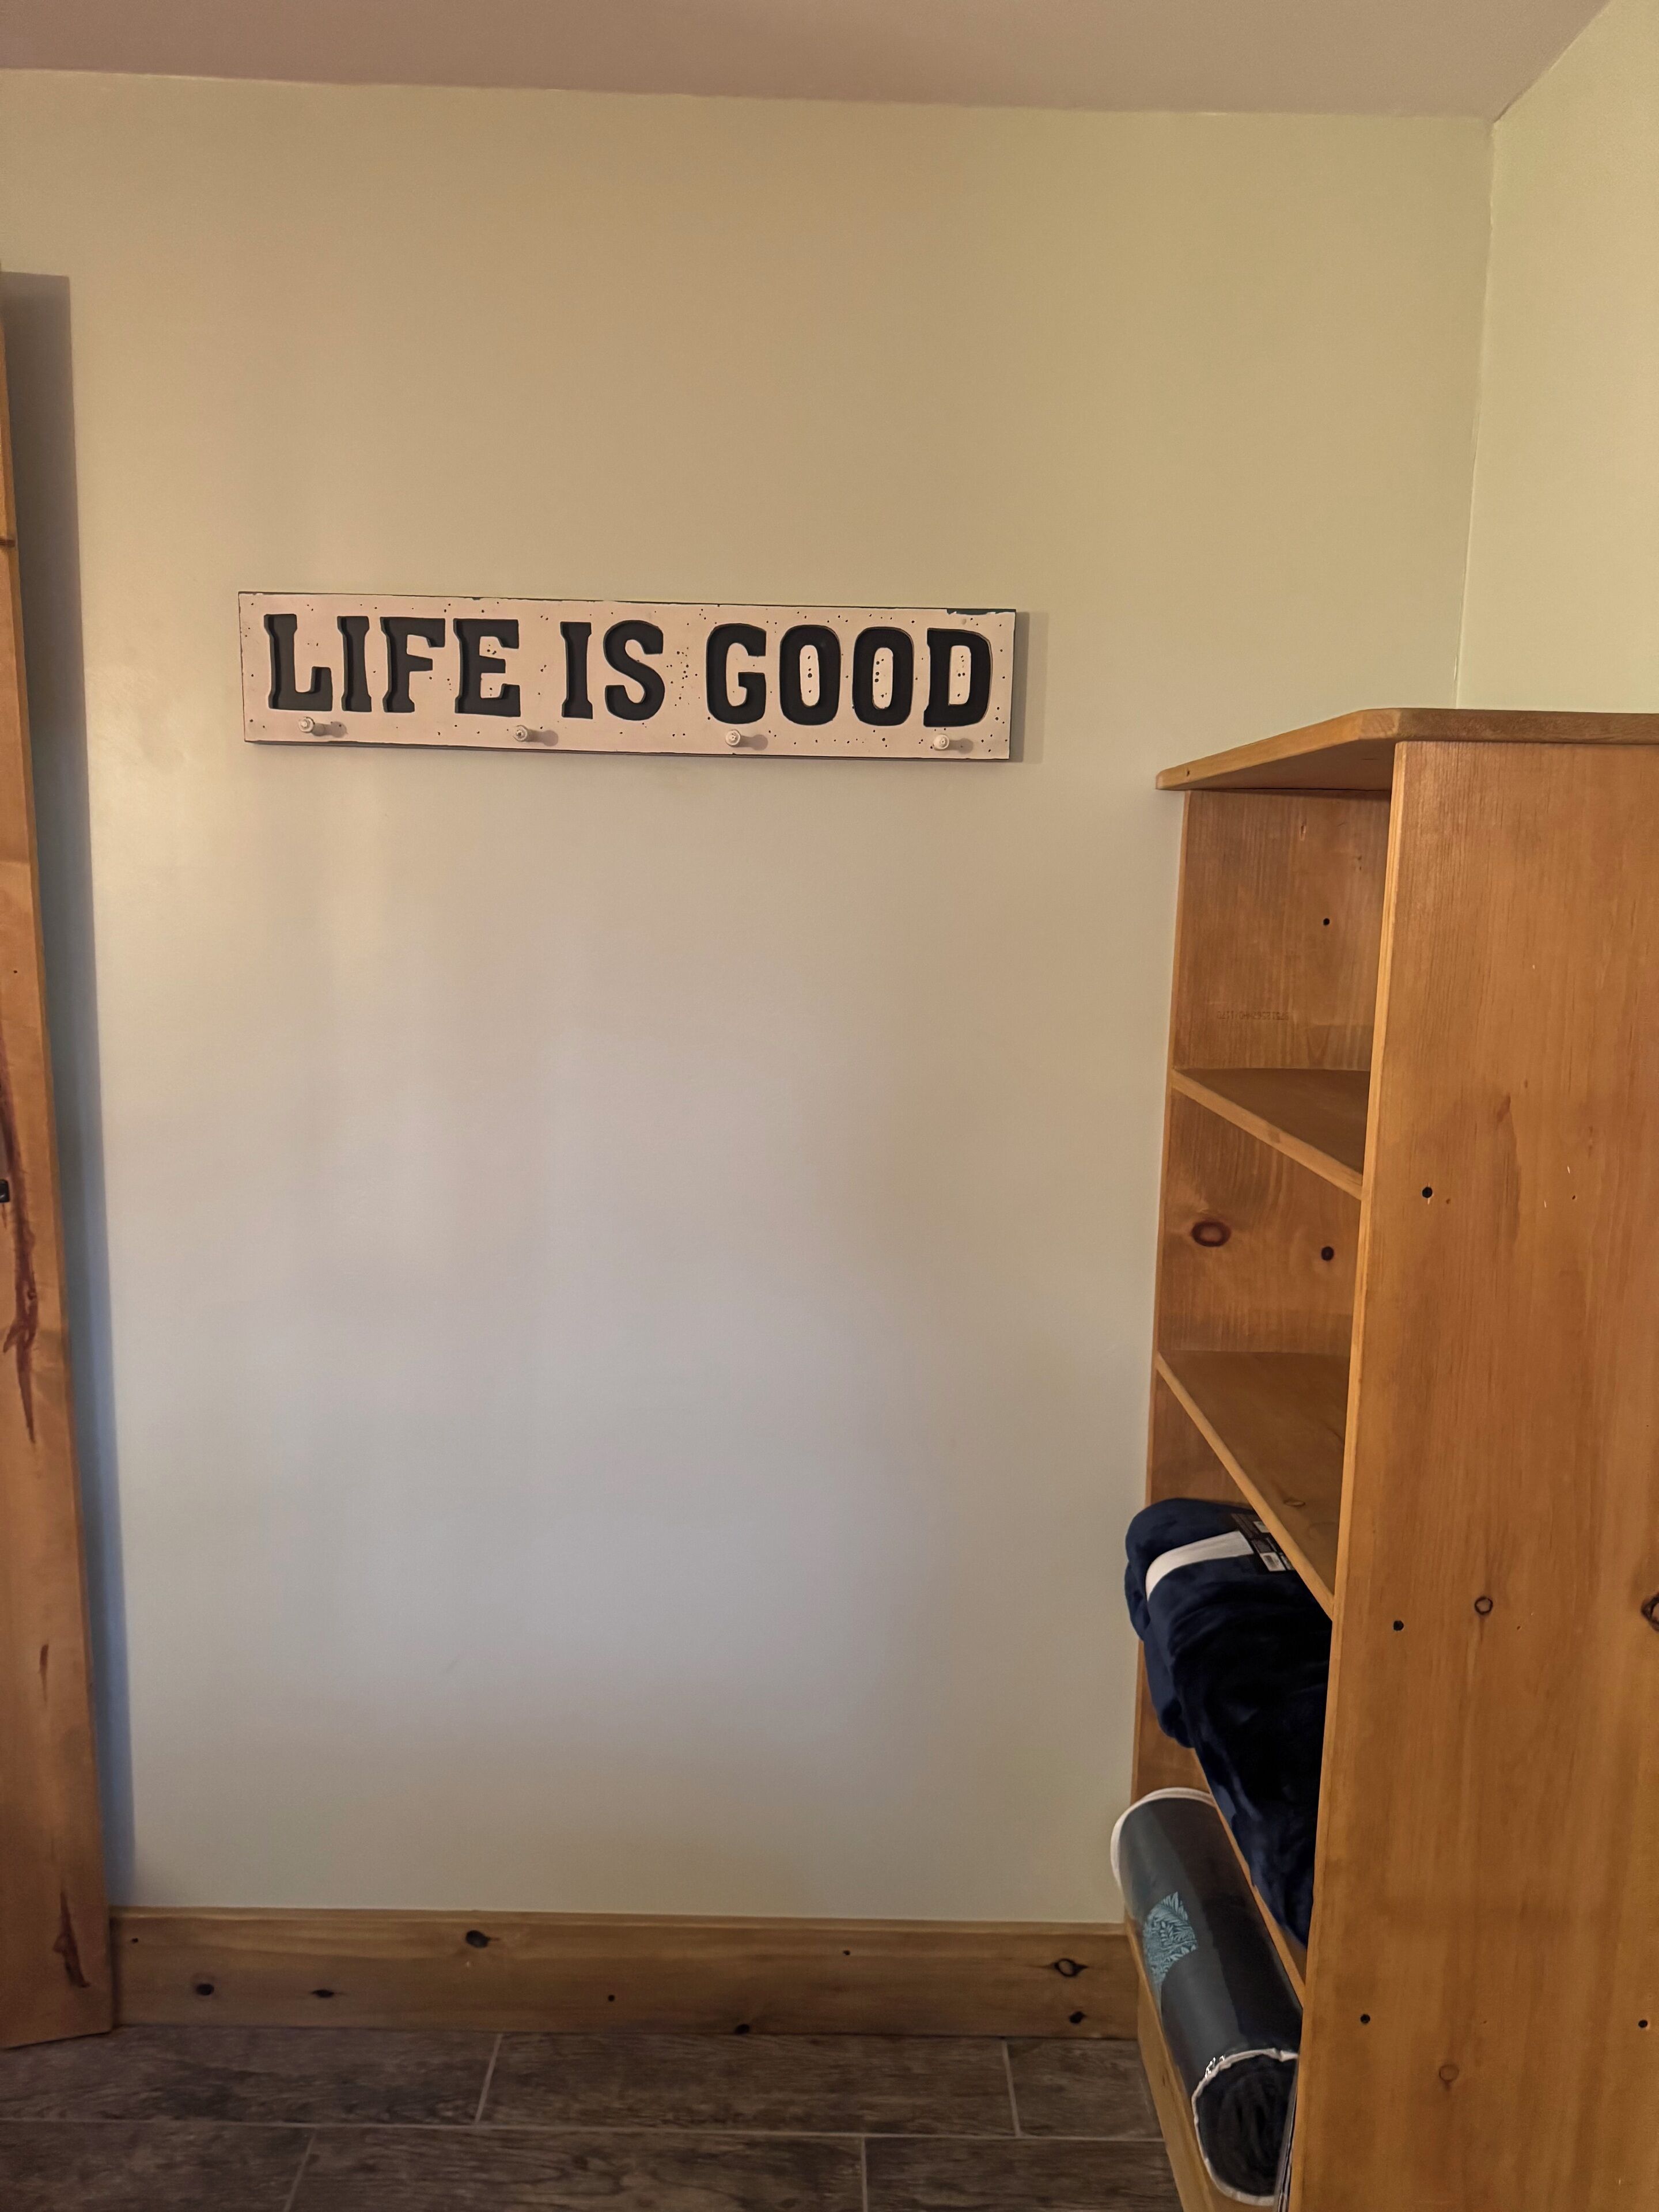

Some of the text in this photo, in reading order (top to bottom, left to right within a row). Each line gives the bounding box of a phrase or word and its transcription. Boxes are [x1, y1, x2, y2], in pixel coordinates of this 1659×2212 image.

[264, 614, 991, 727] LIFE IS GOOD
